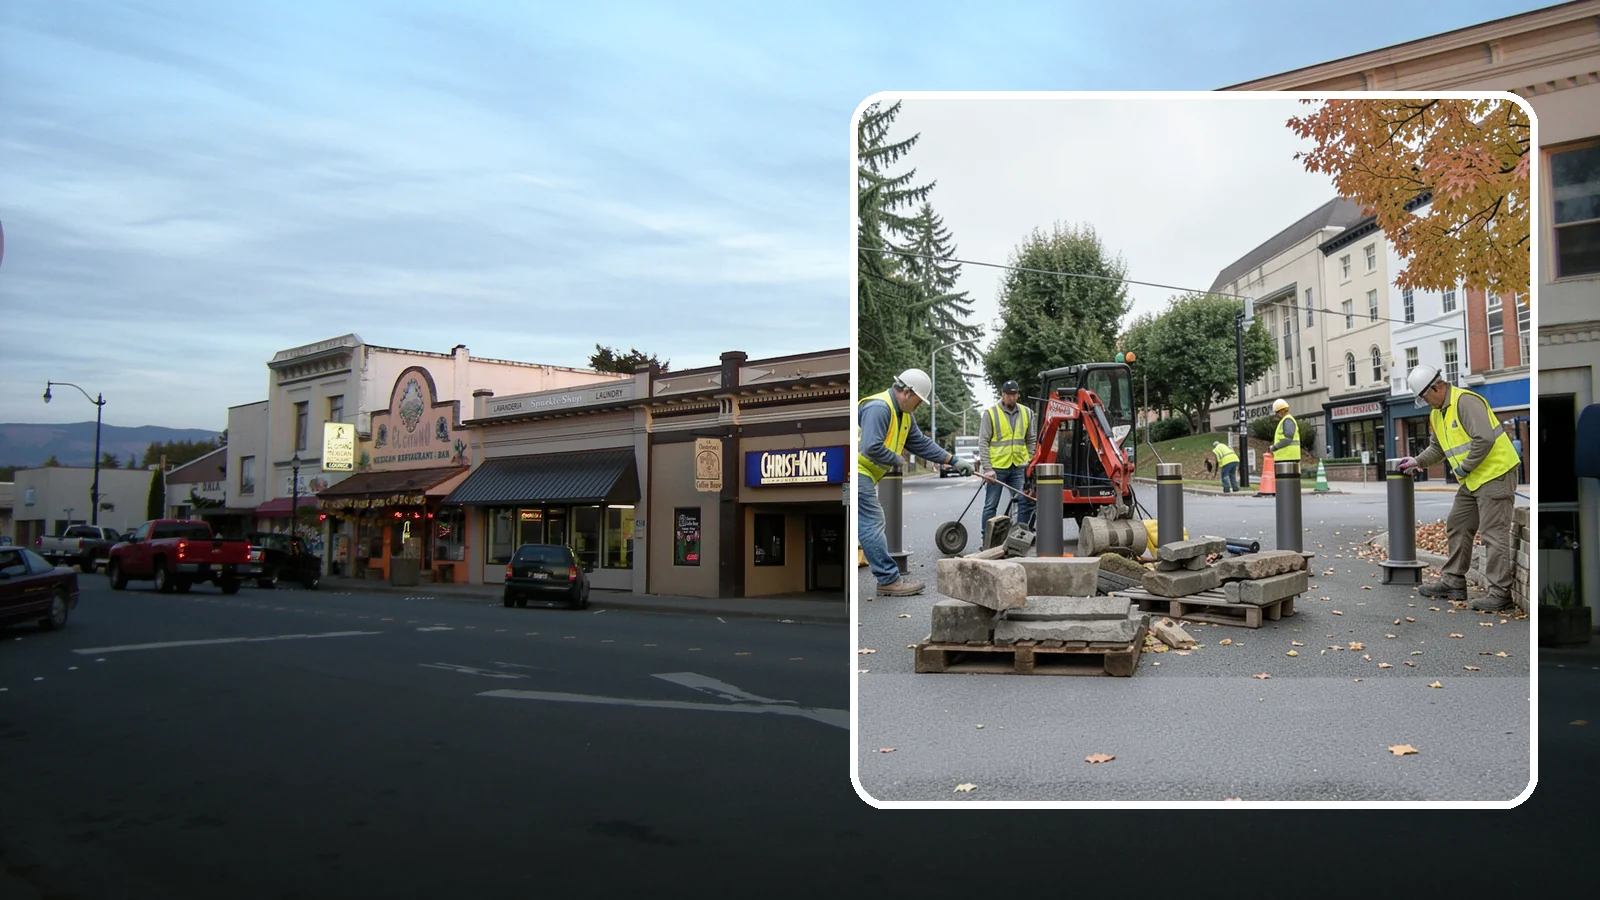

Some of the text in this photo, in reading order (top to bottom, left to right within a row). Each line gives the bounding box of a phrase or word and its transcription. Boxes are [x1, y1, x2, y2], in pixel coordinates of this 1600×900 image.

[493, 388, 624, 413] LAVANDERIA Sparkle Shop LAUNDRY
[373, 450, 450, 464] MEXICAN RESTAURANT BAR
[760, 450, 827, 478] CHRIST KING
